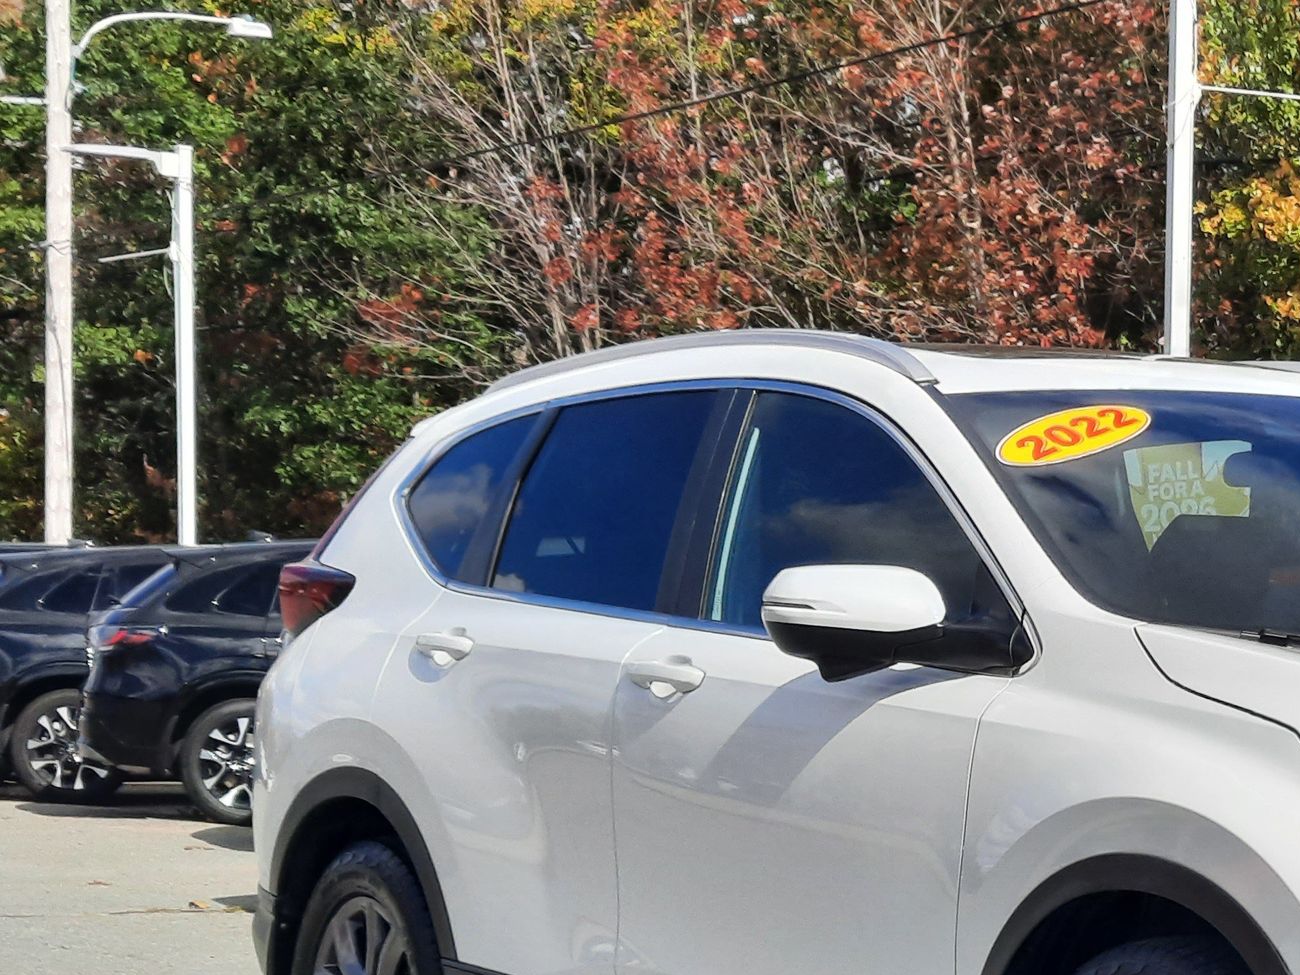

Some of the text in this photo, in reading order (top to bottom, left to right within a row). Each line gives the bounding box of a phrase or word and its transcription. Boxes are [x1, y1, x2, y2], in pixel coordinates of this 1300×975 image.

[1016, 408, 1140, 460] 2022
[1147, 461, 1199, 483] FALL
[1147, 480, 1205, 502] FOR A
